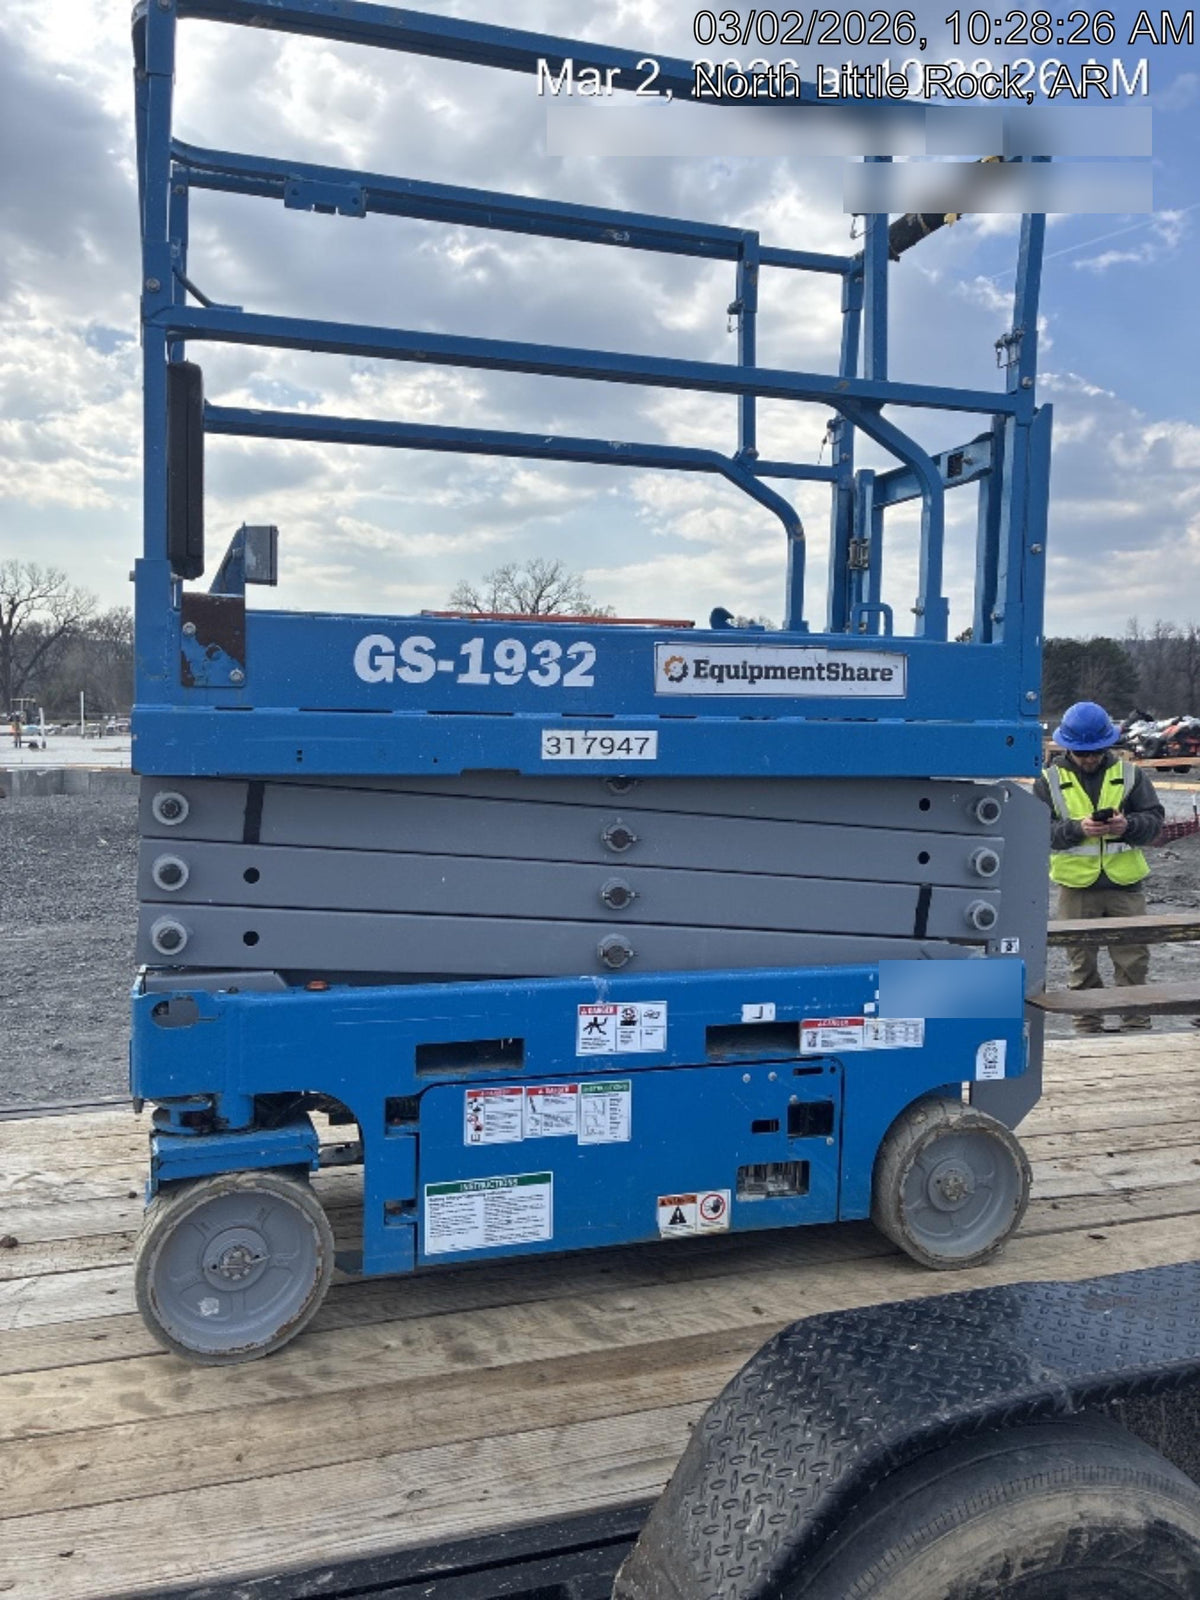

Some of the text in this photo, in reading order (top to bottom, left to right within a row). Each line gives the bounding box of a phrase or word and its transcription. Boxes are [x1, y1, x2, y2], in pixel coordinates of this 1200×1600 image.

[353, 633, 597, 687] GS-1932
[693, 659, 893, 684] EquipmentShare
[545, 736, 650, 755] 317947
